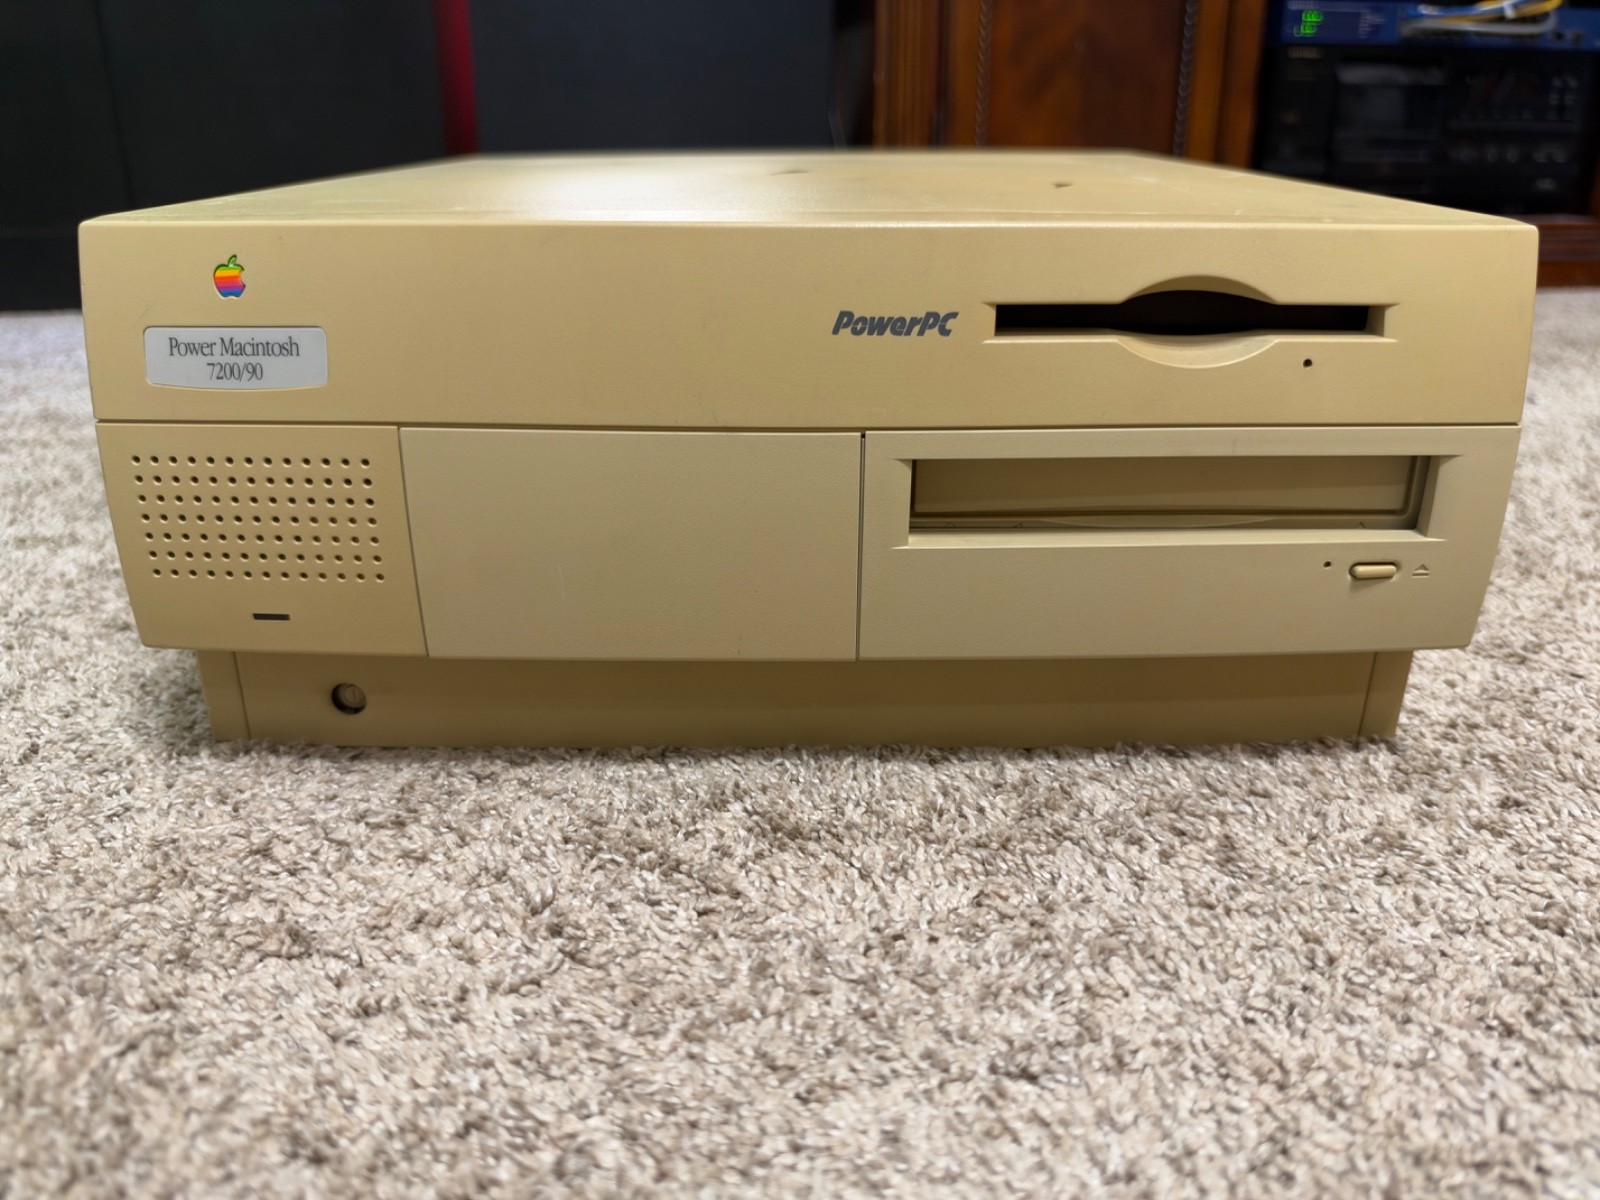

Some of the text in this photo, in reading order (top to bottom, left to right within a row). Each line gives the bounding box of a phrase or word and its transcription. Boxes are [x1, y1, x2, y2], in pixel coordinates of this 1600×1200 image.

[831, 310, 959, 337] PowerPC
[169, 336, 300, 357] Power Macintosh
[206, 362, 264, 382] 7200/90
